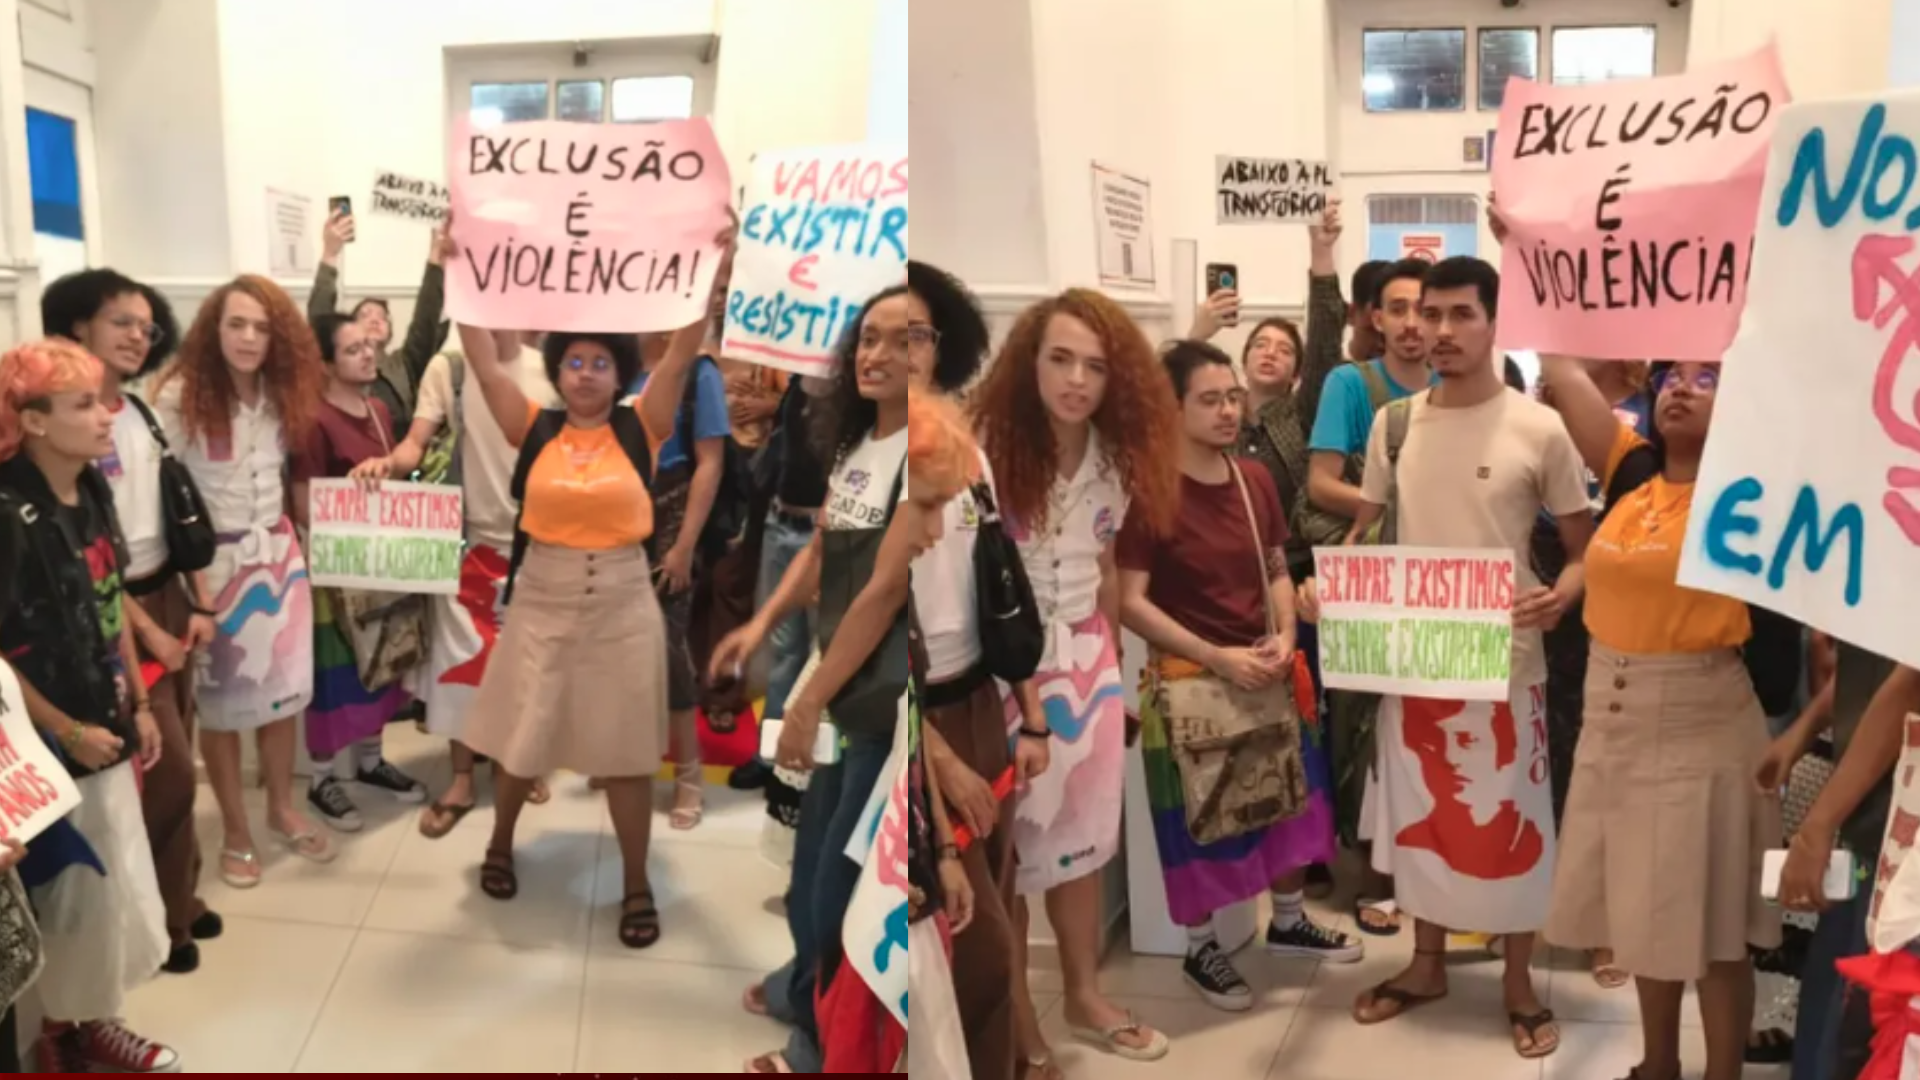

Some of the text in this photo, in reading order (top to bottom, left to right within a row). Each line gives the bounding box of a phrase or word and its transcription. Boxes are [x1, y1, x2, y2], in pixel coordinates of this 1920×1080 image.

[1514, 83, 1772, 159] EXCLUSÃO
[470, 134, 704, 182] EXCLUSÃO
[774, 158, 908, 204] VAMOS
[1222, 160, 1289, 185] ABAIXO
[566, 191, 593, 237] É
[1596, 163, 1631, 231] É
[743, 198, 907, 260] EXISTIR
[465, 237, 700, 298] VIOLÊNCIA!
[788, 254, 819, 290] E
[380, 489, 460, 531] EXISTIMOS
[1706, 477, 1864, 607] EM
[1318, 555, 1514, 610] SEMPRE EXISTIMOS
[1320, 617, 1393, 676] SEMPRE
